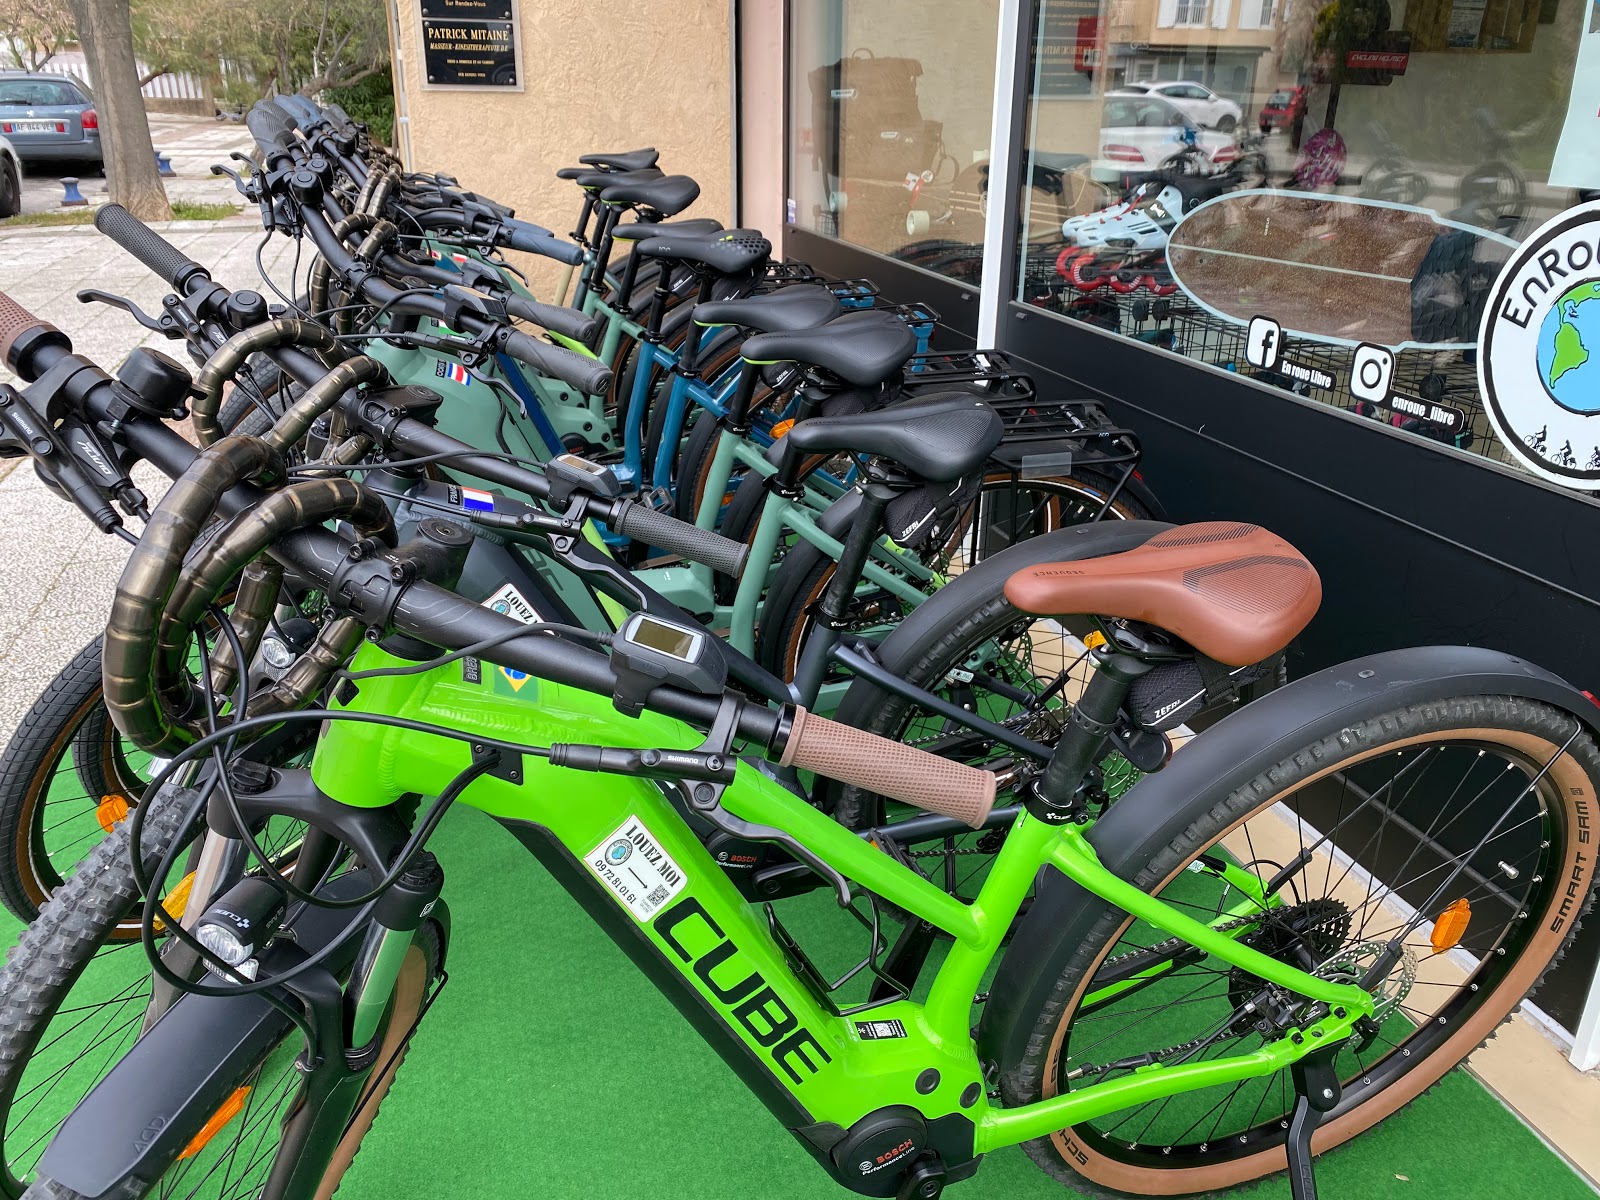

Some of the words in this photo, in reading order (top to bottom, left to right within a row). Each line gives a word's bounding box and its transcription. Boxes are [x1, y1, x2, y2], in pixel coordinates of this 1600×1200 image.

[428, 28, 468, 39] PATRICK
[471, 29, 508, 40] MITAINE
[1282, 360, 1291, 374] En
[1291, 364, 1310, 380] roue
[1310, 370, 1332, 389] Libre
[1392, 396, 1454, 426] enroue_libre
[504, 590, 534, 622] LOUEZ
[668, 755, 698, 764] SHIMANO
[1575, 800, 1590, 844] SAM
[626, 824, 663, 866] LOUEZ
[656, 860, 681, 888] MOI
[595, 860, 606, 872] 09
[603, 869, 615, 881] 72
[612, 878, 621, 889] 81
[619, 885, 629, 897] 01
[626, 893, 637, 905] 61
[1550, 852, 1586, 934] SMART
[653, 896, 832, 1085] CUBE
[876, 1138, 913, 1163] BOSCH
